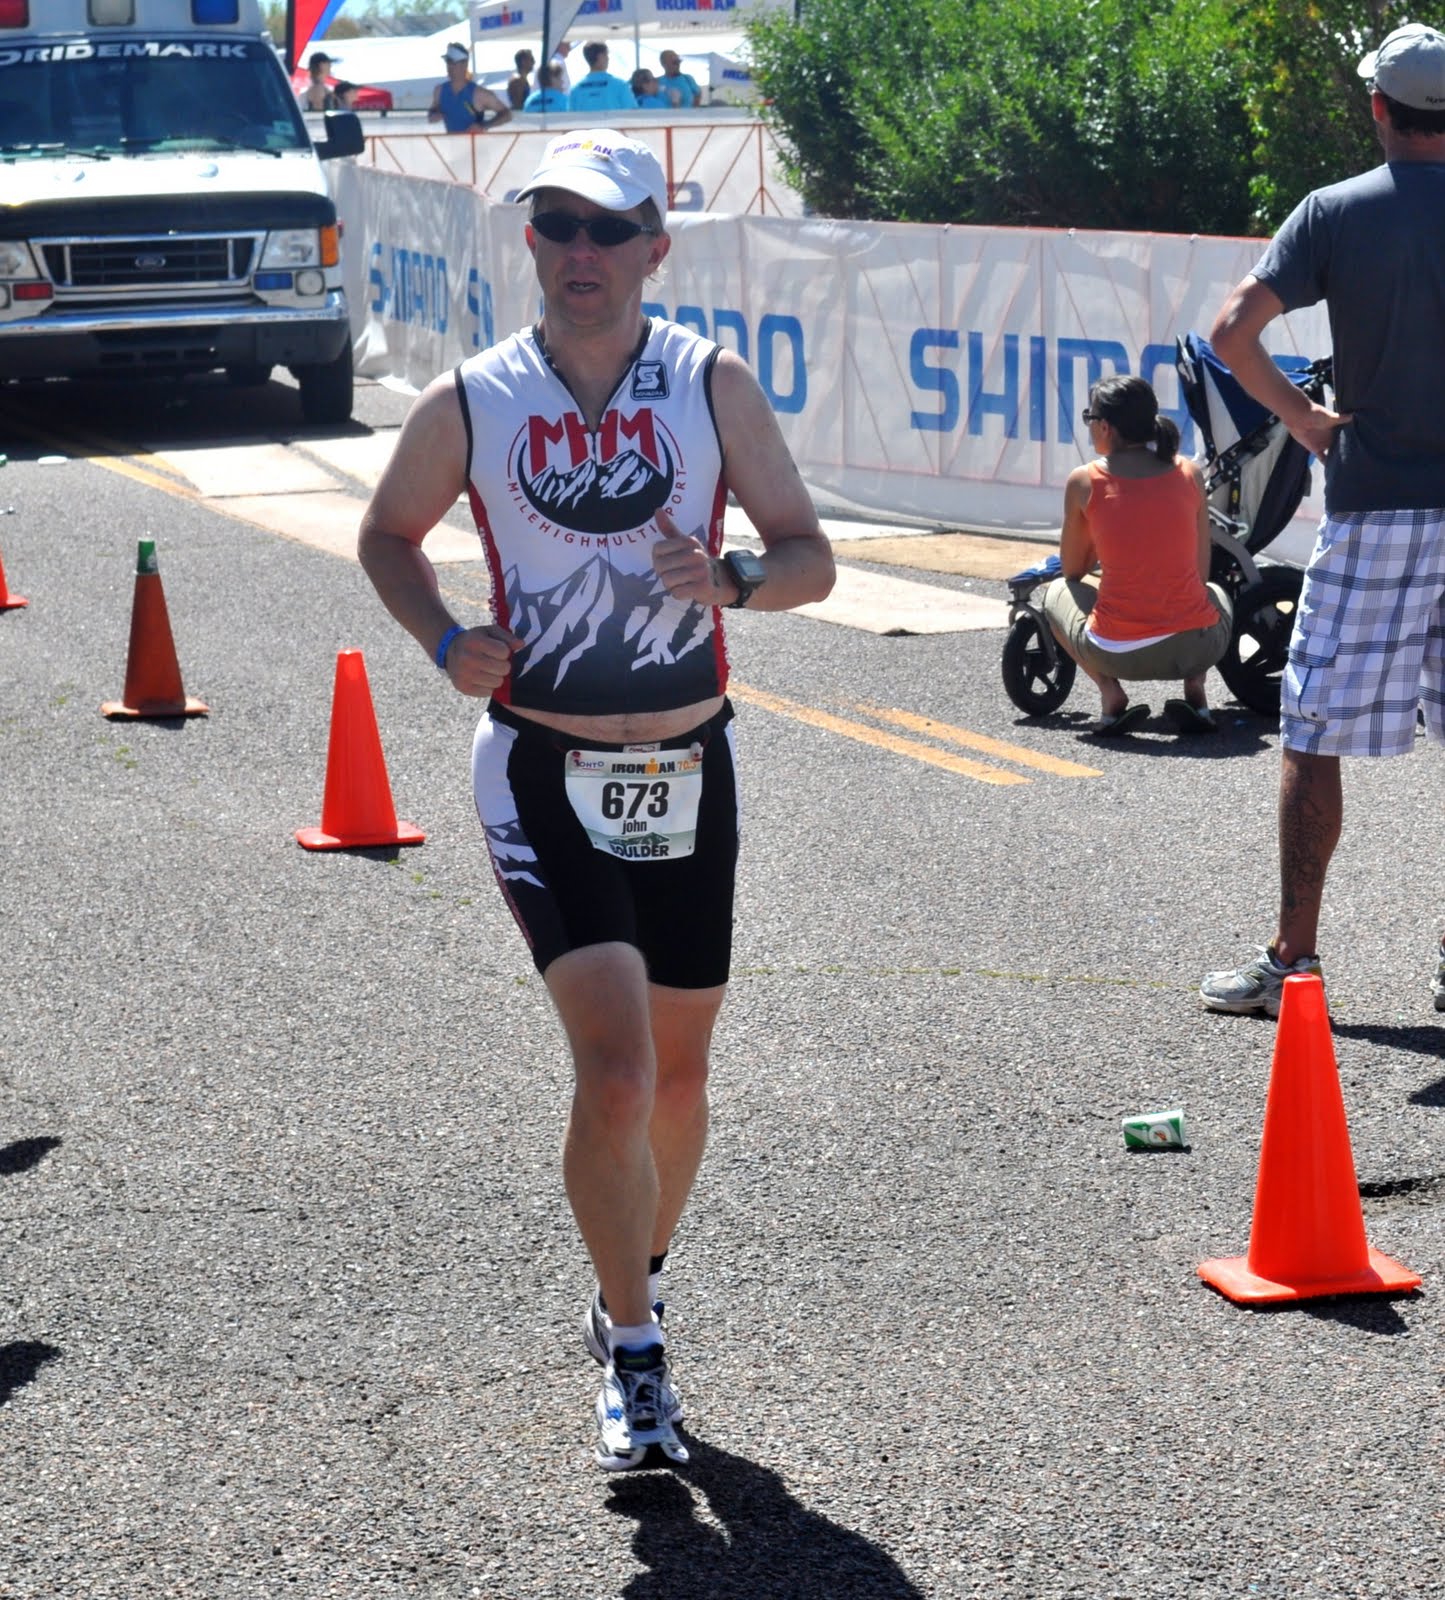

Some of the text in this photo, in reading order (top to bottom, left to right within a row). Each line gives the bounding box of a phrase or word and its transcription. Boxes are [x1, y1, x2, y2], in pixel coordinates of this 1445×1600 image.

[528, 407, 661, 478] MHM
[611, 757, 676, 775] IRONMAN
[601, 781, 670, 820] 673
[622, 819, 648, 835] john
